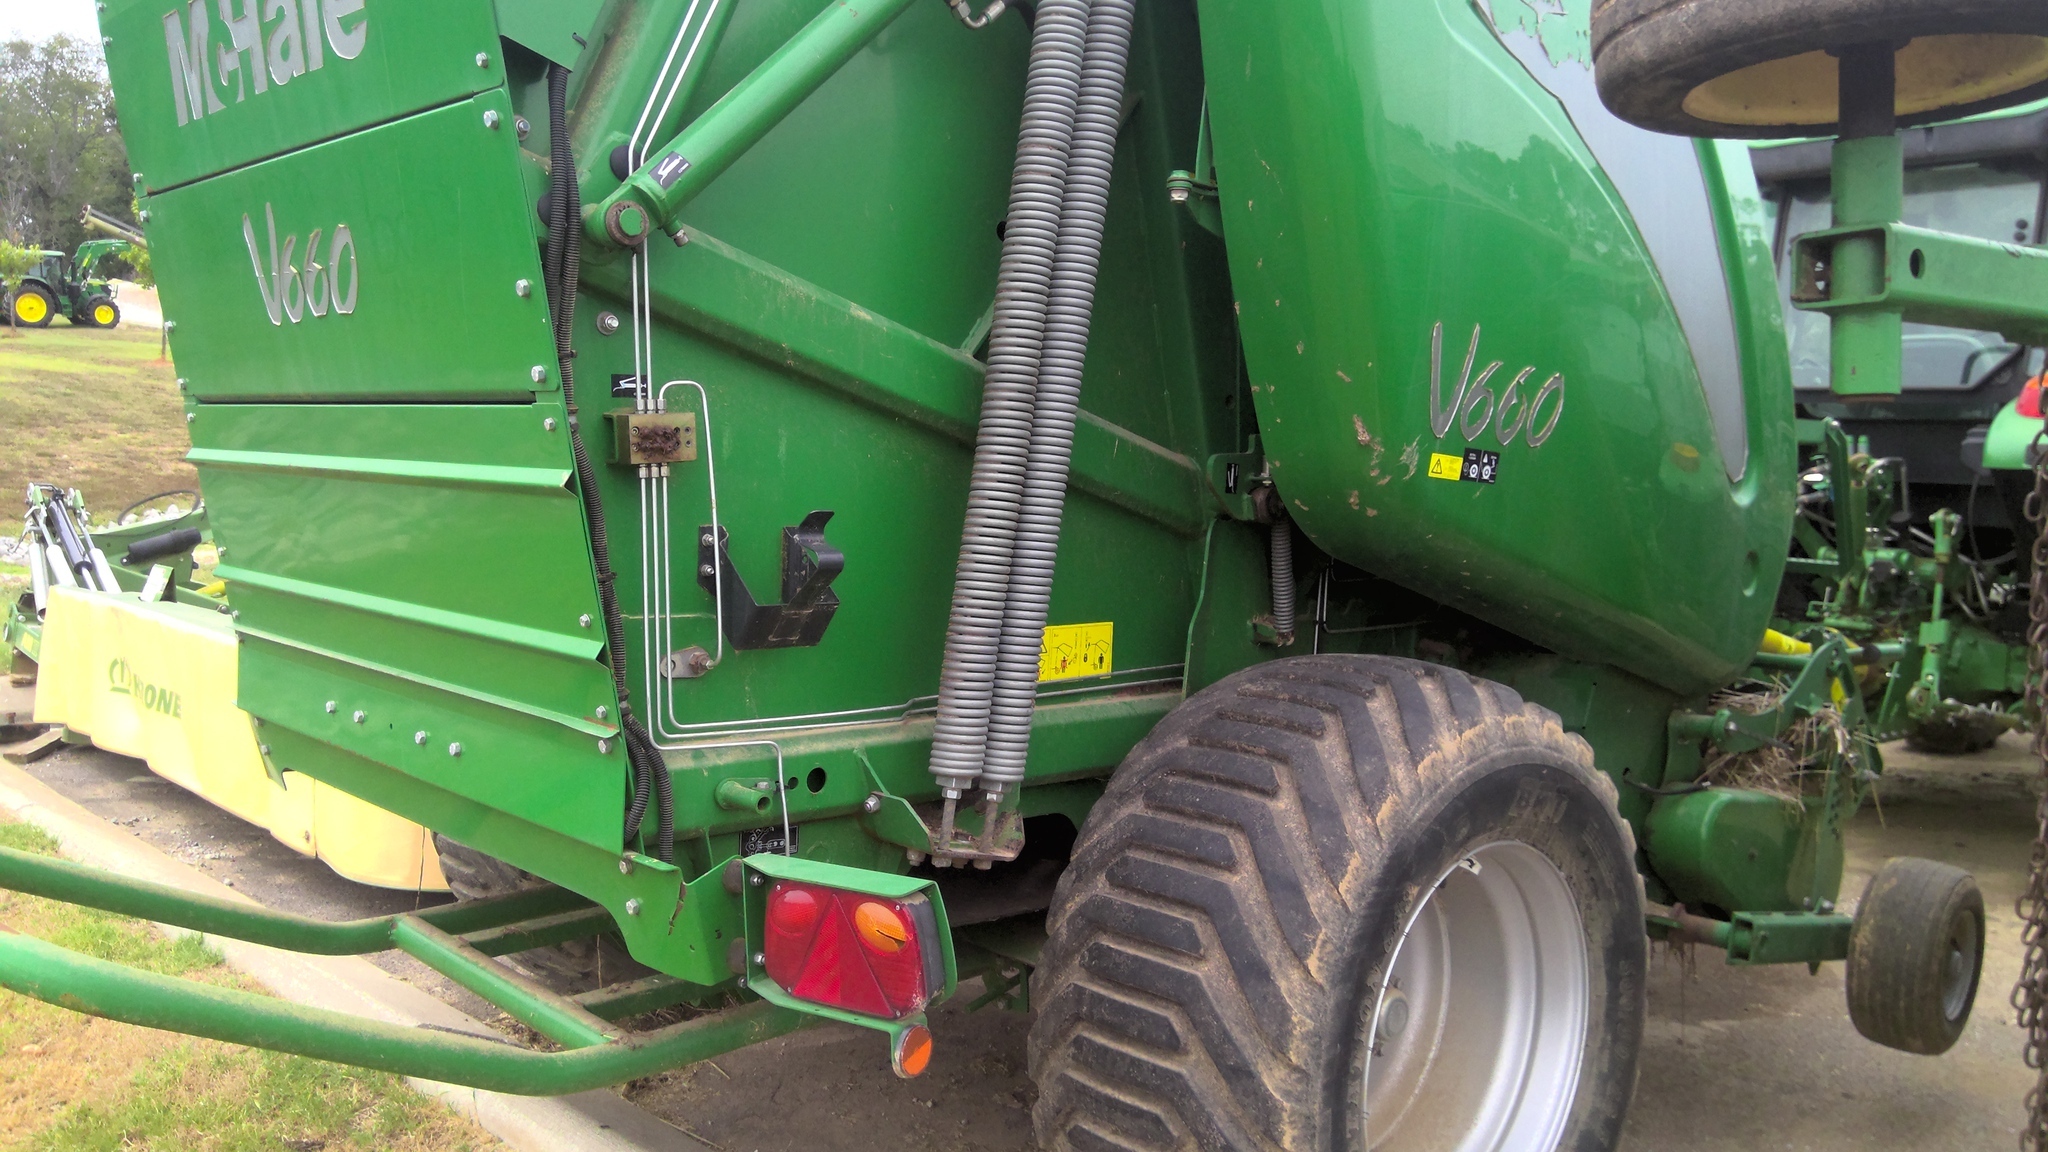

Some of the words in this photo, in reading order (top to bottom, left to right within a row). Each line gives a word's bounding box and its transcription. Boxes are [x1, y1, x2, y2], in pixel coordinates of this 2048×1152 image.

[163, 0, 367, 127] McHale
[243, 202, 359, 326] V660
[1430, 321, 1565, 448] V660
